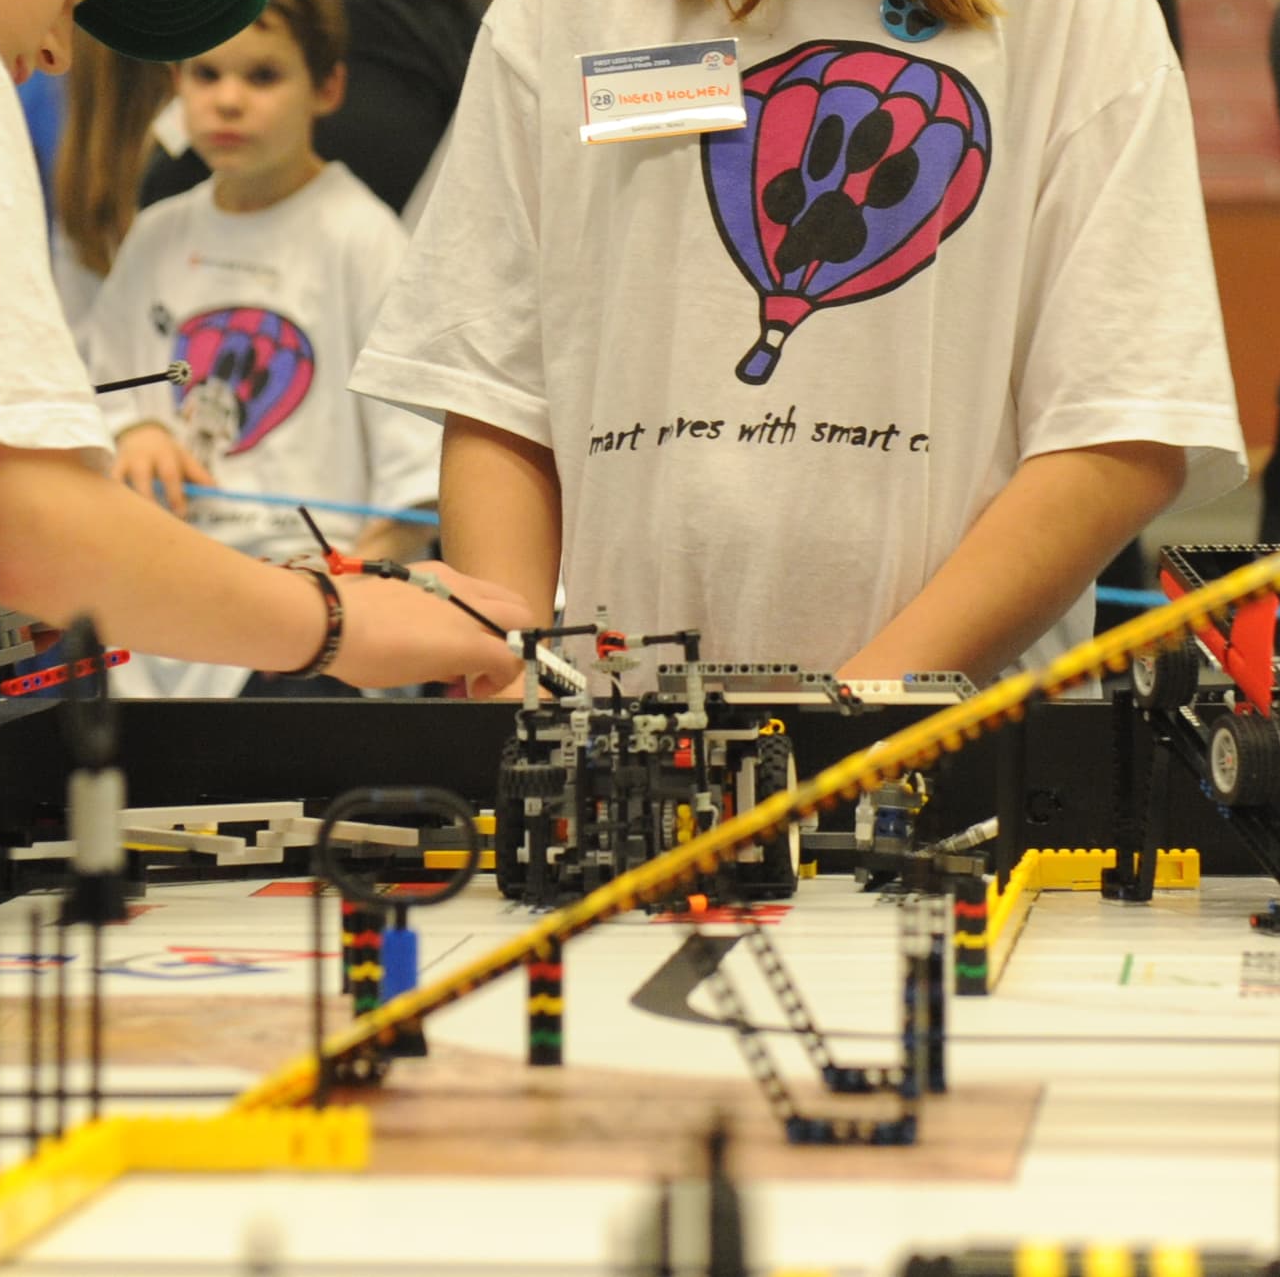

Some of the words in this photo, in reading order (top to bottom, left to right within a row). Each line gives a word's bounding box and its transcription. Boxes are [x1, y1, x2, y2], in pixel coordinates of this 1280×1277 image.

[592, 94, 612, 106] 28
[618, 91, 664, 105] INGRID
[588, 422, 647, 456] mart
[737, 404, 798, 446] with
[810, 421, 902, 453] smart
